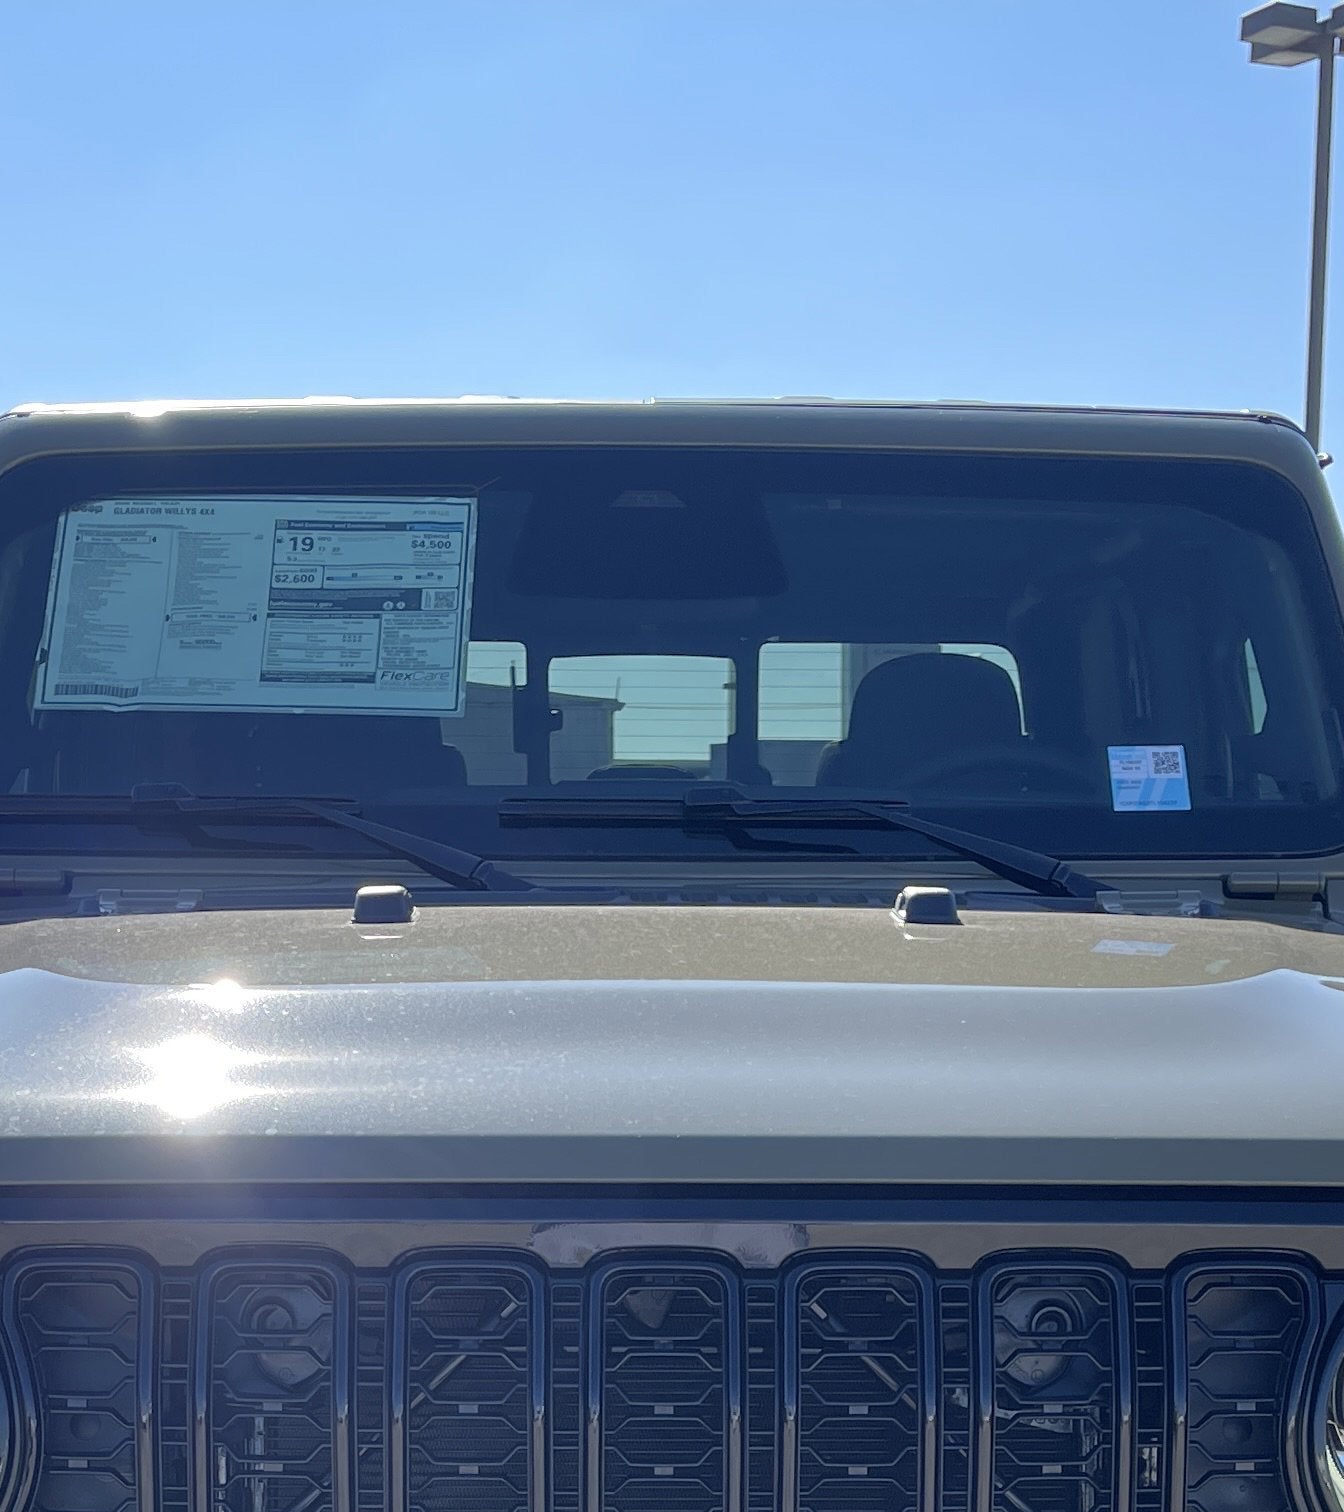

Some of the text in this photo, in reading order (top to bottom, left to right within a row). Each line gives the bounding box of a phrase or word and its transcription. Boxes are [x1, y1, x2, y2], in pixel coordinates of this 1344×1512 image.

[114, 507, 162, 515] GLADIATOR
[165, 507, 197, 515] WILLYS
[289, 536, 314, 552] 19
[411, 540, 452, 550] $4,500
[274, 574, 315, 584] $2,600
[379, 671, 450, 682] FlexCare
